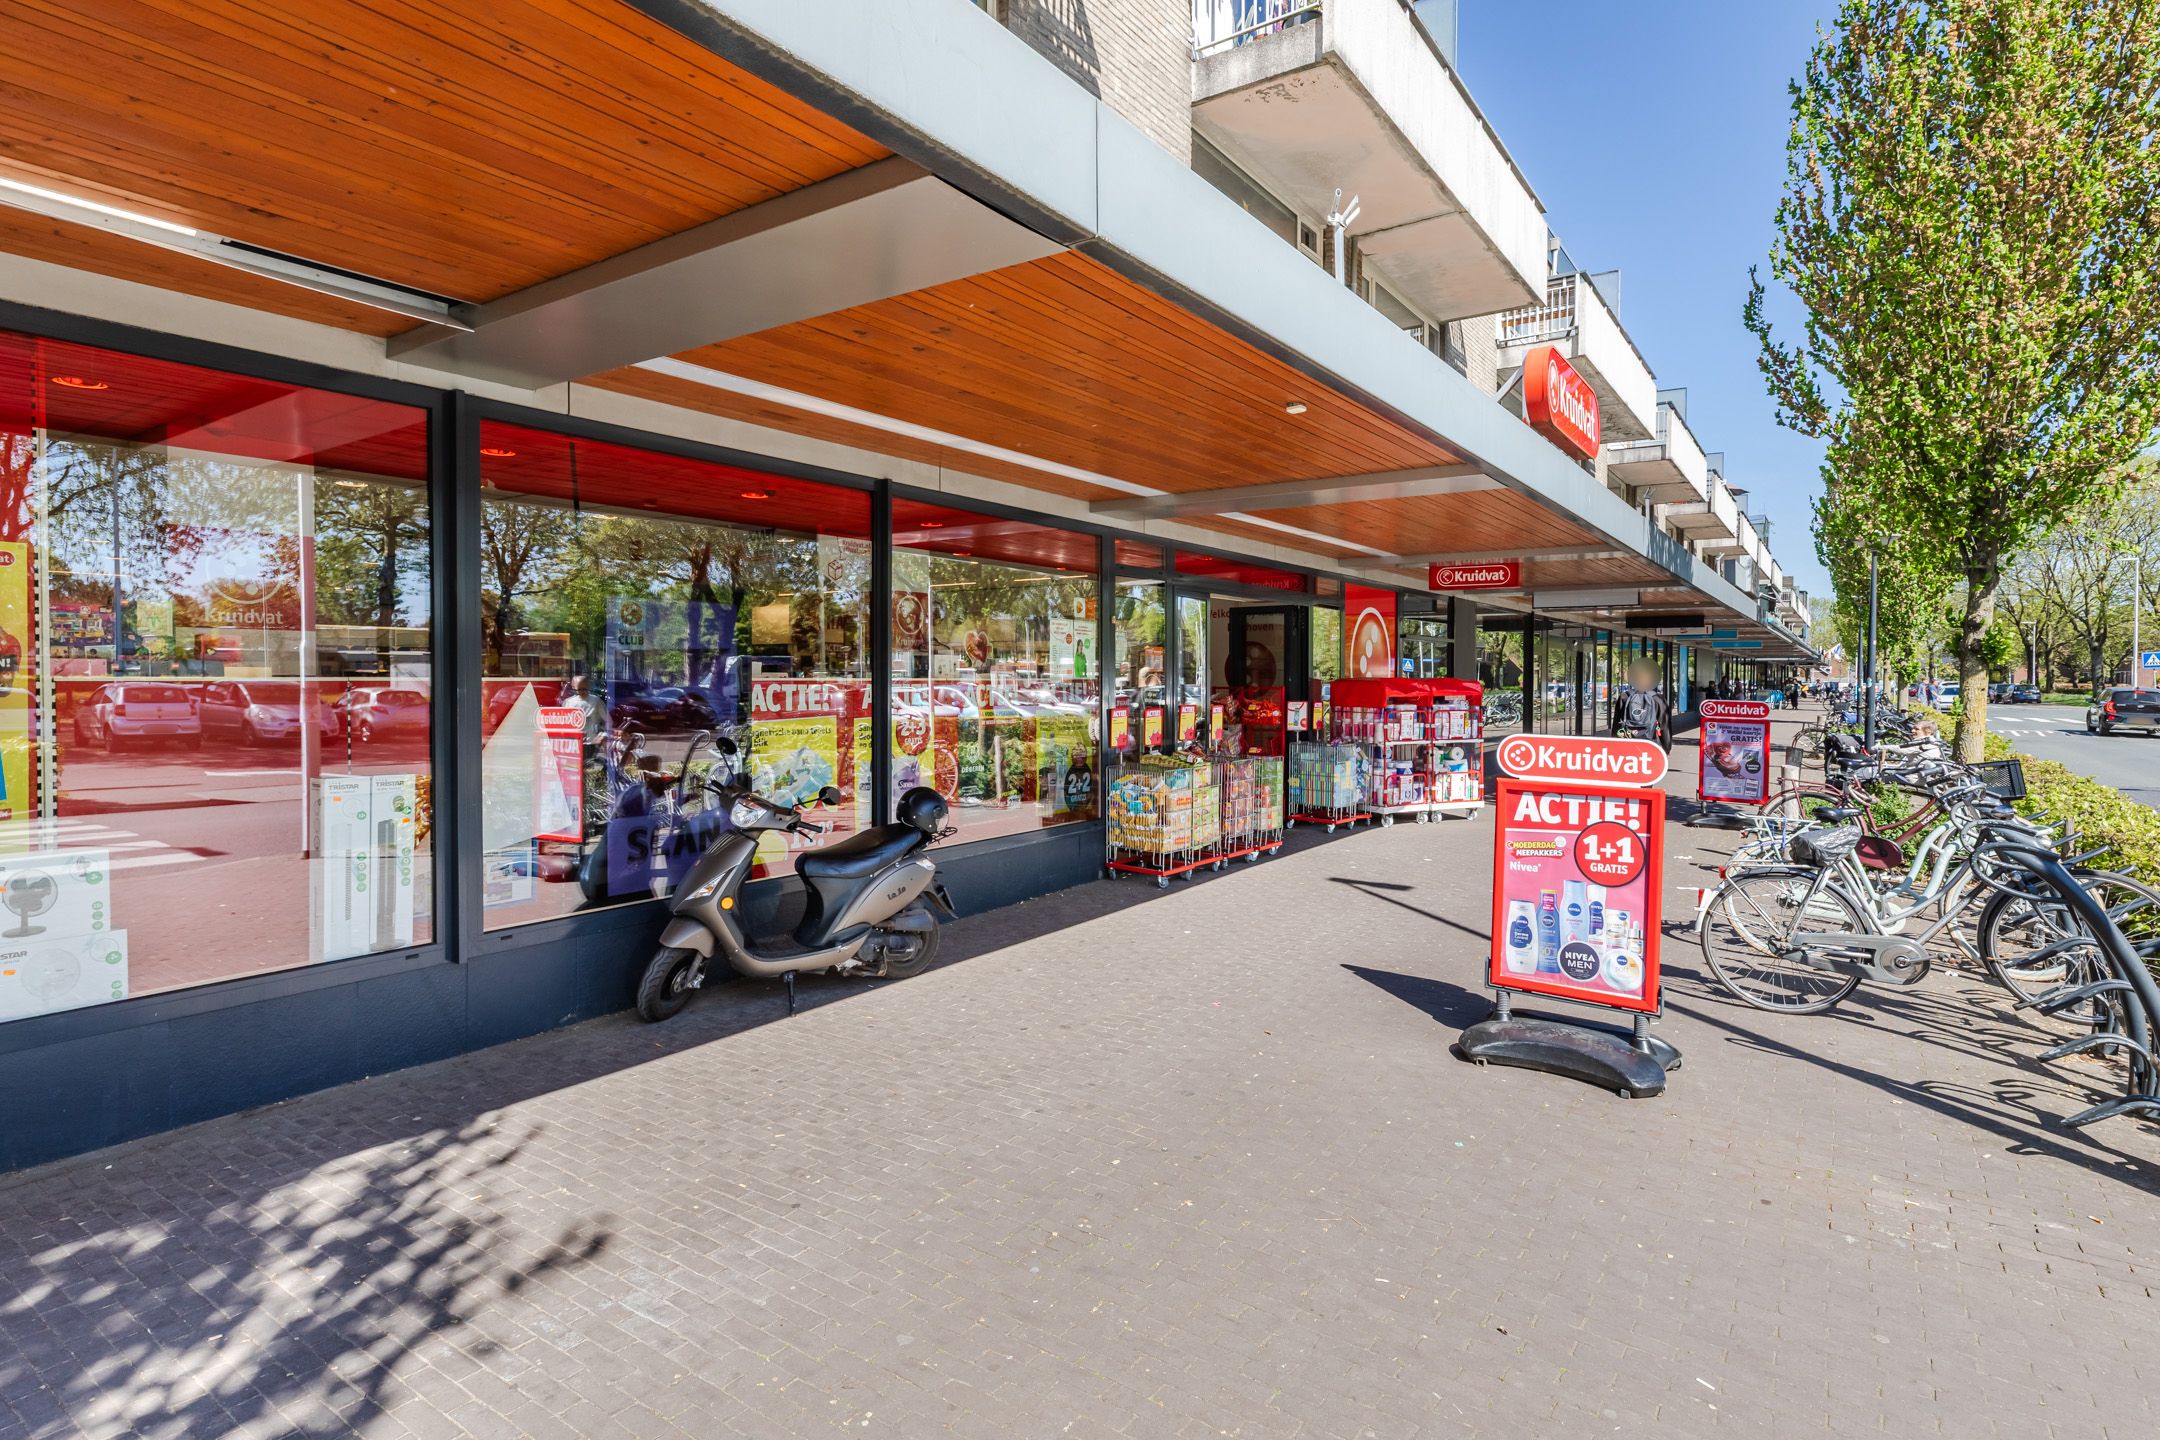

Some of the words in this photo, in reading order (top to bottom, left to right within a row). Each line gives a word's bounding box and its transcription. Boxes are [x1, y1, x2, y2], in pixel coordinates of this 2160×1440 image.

[1560, 374, 1595, 442] Kruidvat
[1454, 570, 1504, 582] Kruidvat
[204, 607, 283, 624] Kruidvat
[751, 683, 830, 713] ACTIE!
[1717, 704, 1765, 716] Kruidvat
[1731, 735, 1762, 743] GRATIS!
[1538, 745, 1652, 775] Kruidvat
[1513, 791, 1640, 831] ACTIE!
[1513, 840, 1556, 849] MOEDERDAG
[1583, 834, 1635, 864] 1+1
[1516, 849, 1563, 857] MEEPAKKERS
[1590, 862, 1628, 875] GRATIS
[1565, 951, 1596, 963] NIVEA
[1567, 960, 1593, 970] MEN
